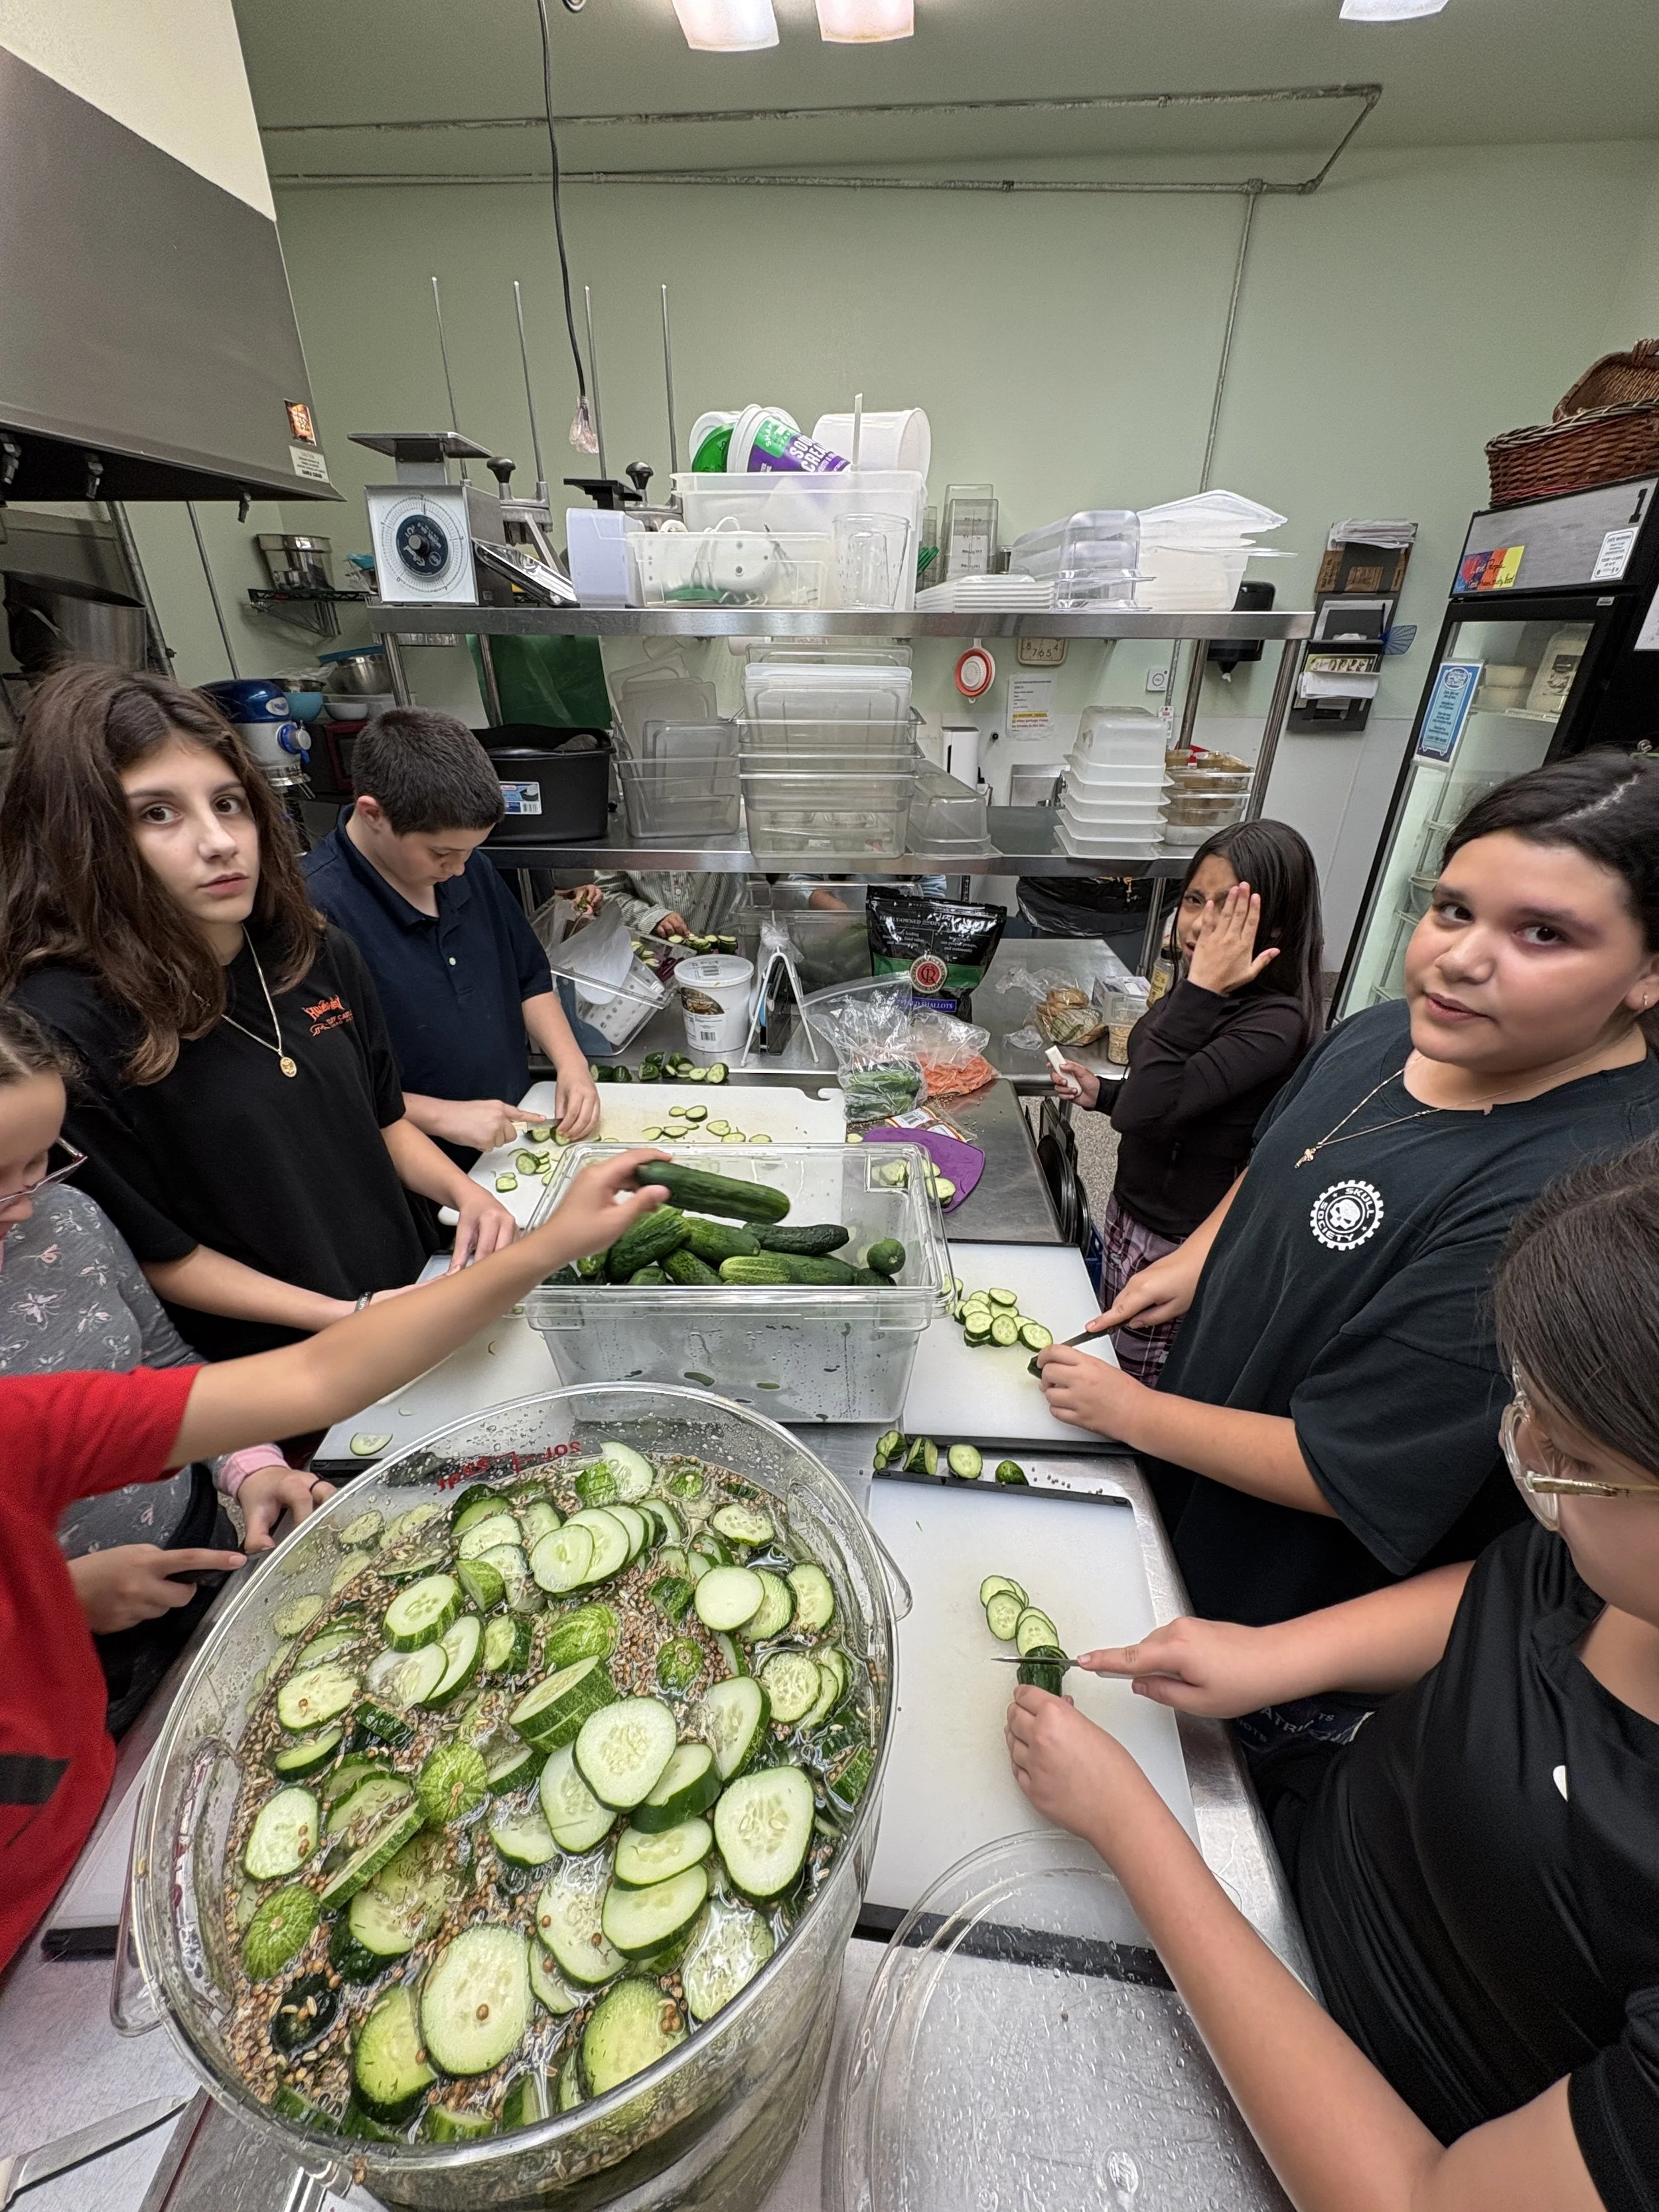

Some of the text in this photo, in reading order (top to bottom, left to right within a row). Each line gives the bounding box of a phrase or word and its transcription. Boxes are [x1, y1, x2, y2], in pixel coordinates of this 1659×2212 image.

[789, 435, 814, 459] SOU
[1628, 488, 1648, 524] 1
[1026, 642, 1031, 650] 8
[1039, 649, 1045, 658] 6
[879, 915, 921, 924] FALY-OWNED
[1345, 1188, 1374, 1218] SKULL
[1318, 1201, 1354, 1241] SOCIETY
